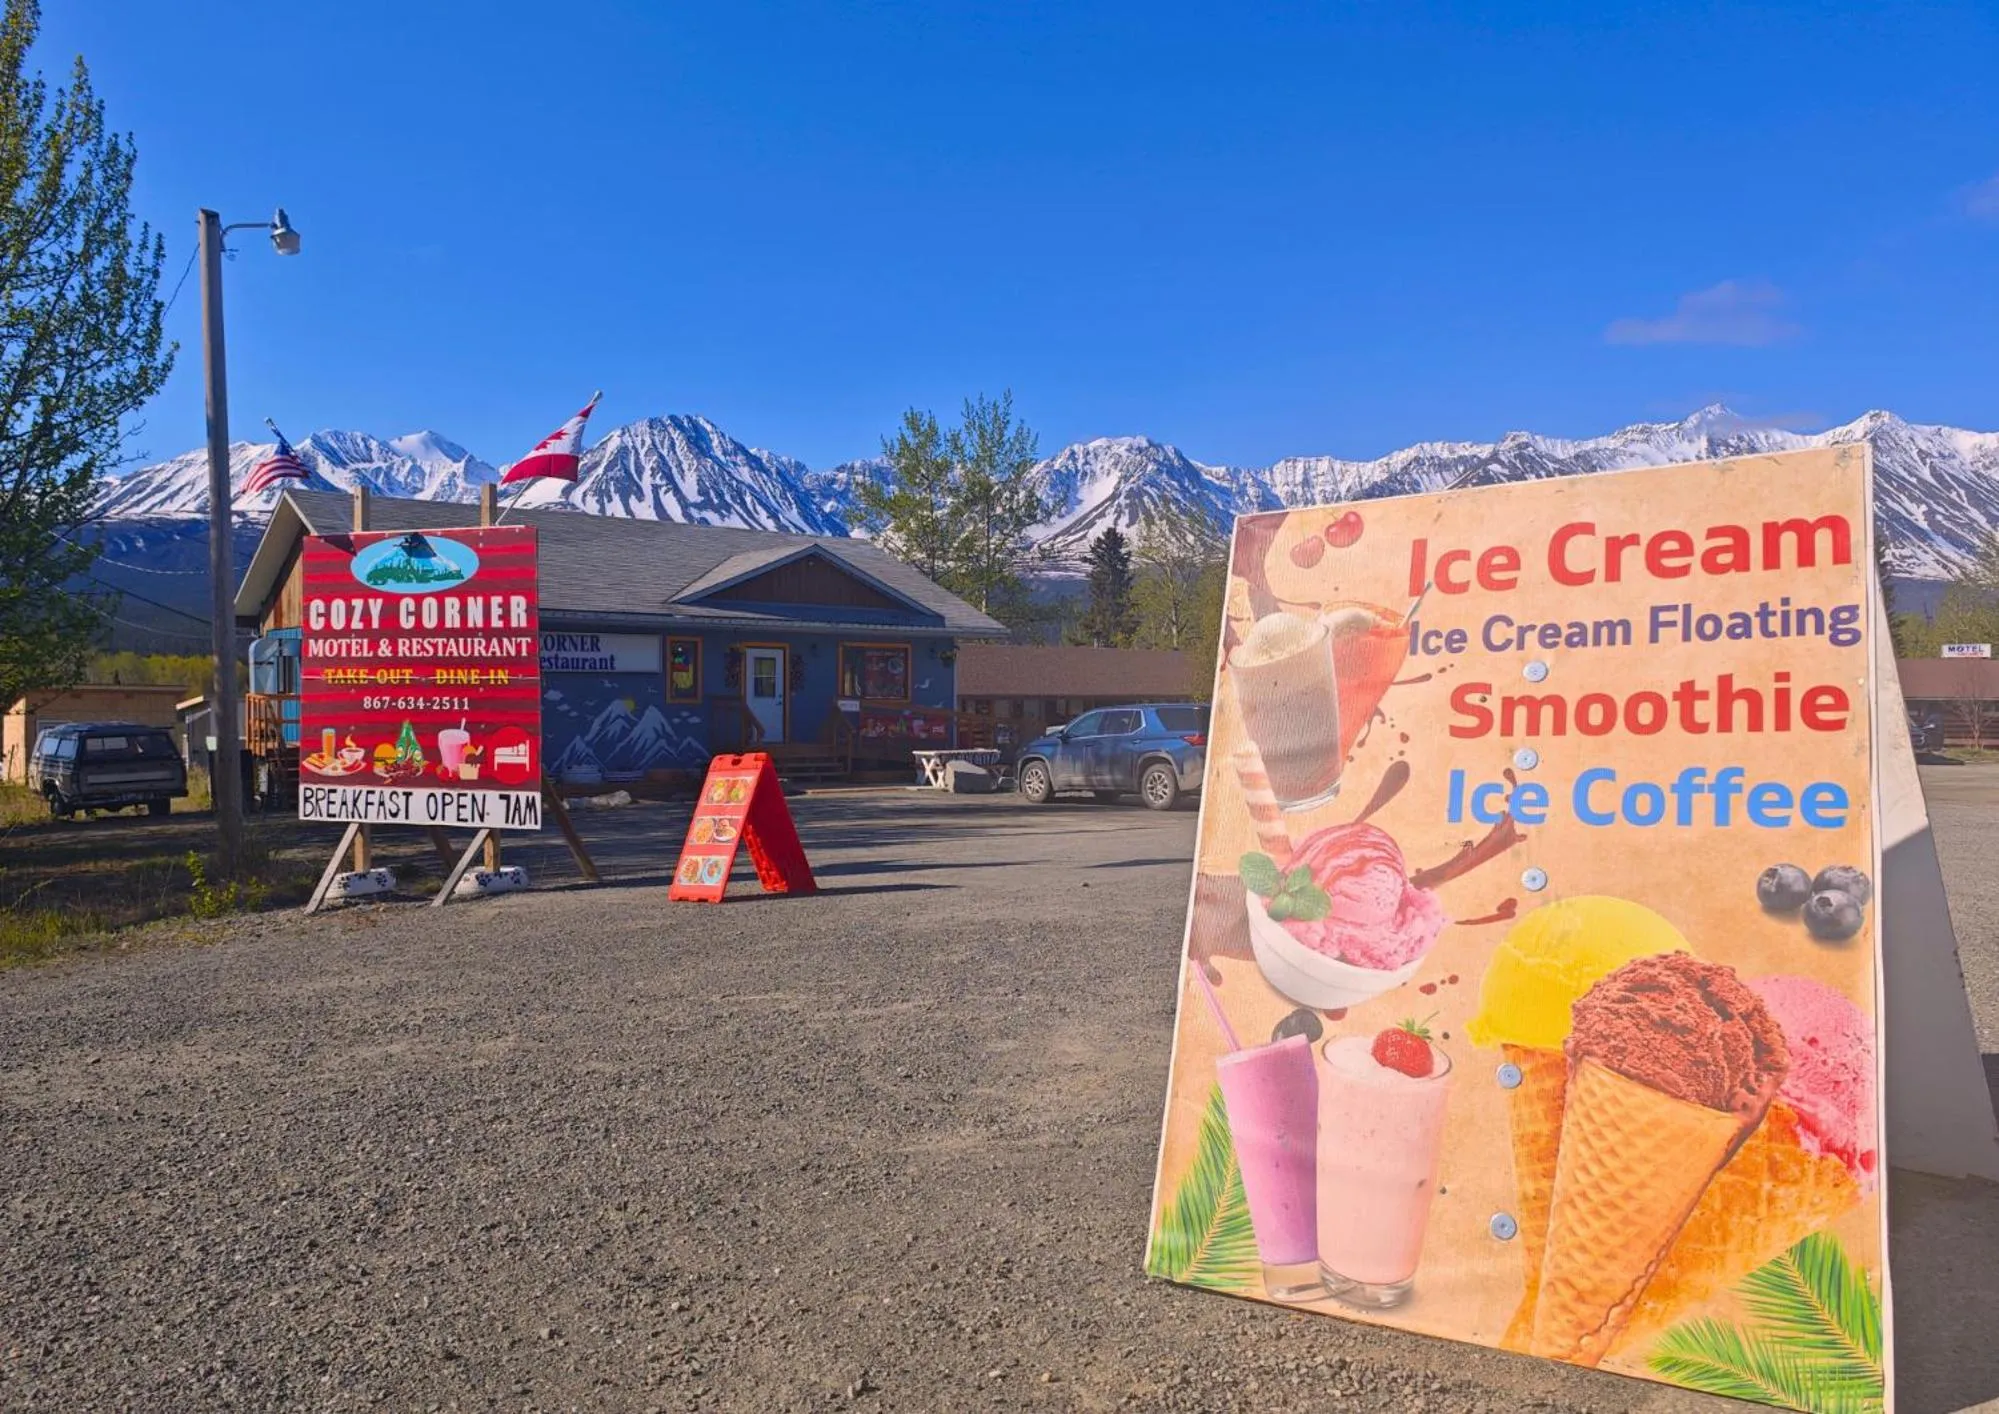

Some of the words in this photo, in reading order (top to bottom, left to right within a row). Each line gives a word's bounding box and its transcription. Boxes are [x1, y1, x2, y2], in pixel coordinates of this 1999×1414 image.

[1408, 538, 1521, 598] Ice
[1547, 514, 1852, 588] Cream
[309, 598, 384, 631] COZY
[399, 595, 528, 630] CORNER
[1409, 620, 1467, 656] Ice
[1481, 614, 1631, 652] Cream
[1649, 597, 1862, 647] Floating
[308, 638, 373, 658] MOTEL
[378, 638, 392, 656] &
[398, 636, 531, 658] RESTAURANT
[541, 634, 600, 652] ORNER
[324, 668, 369, 684] TAKE
[376, 668, 413, 684] OUT
[436, 668, 481, 685] DINE
[488, 668, 510, 685] IN
[540, 654, 615, 670] estaurant
[363, 696, 470, 710] 867-634-2511
[1448, 671, 1850, 739] Smoothie
[302, 787, 413, 821] BREAKFAST
[426, 792, 487, 823] OPEN
[499, 793, 538, 826] 7AM
[1447, 768, 1549, 825] Ice
[1572, 766, 1850, 828] Coffee
